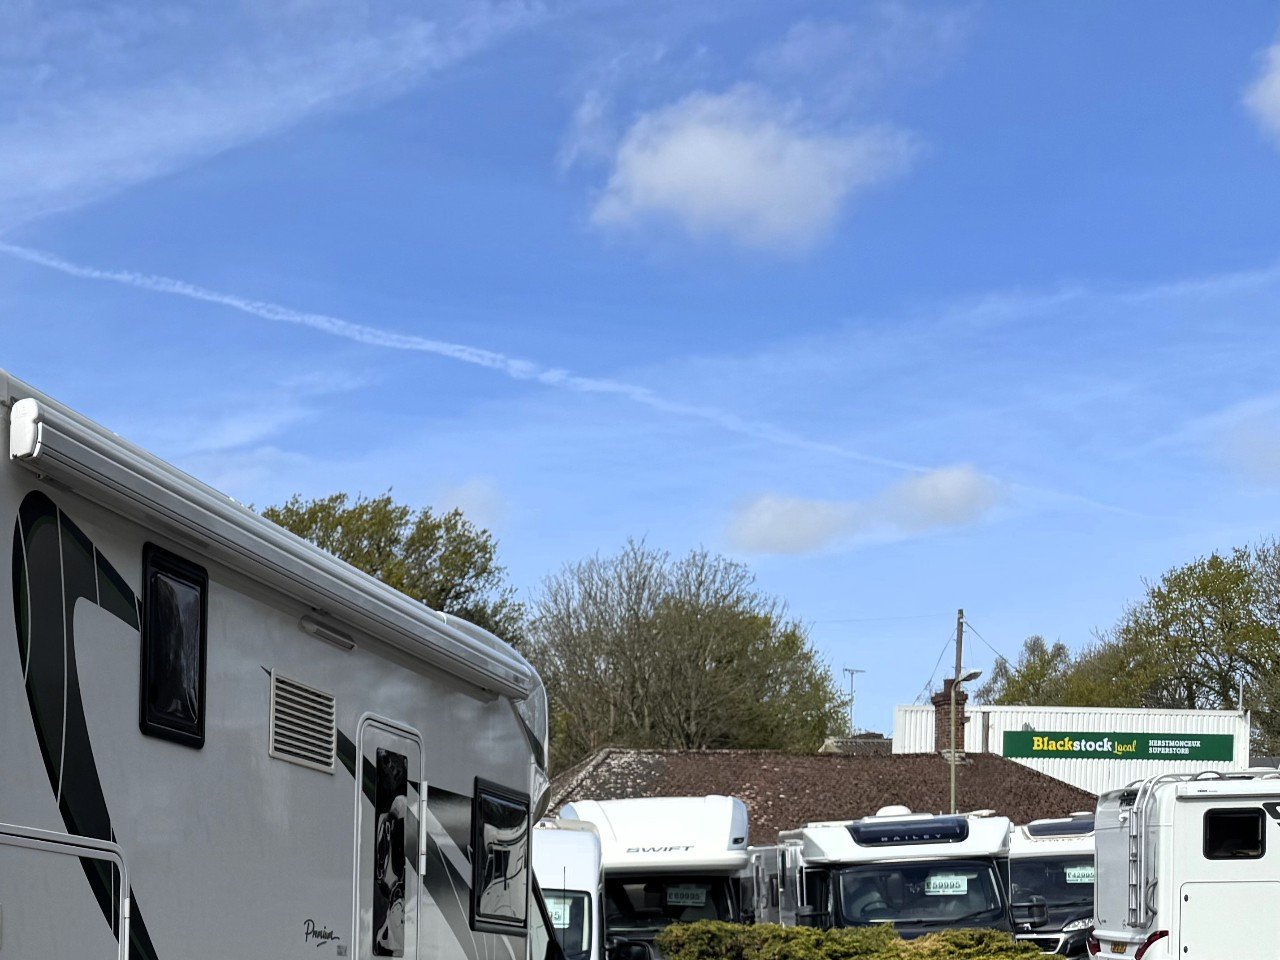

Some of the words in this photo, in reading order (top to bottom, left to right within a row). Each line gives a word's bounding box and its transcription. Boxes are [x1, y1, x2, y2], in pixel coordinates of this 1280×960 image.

[1032, 736, 1113, 752] Blackstock
[1113, 739, 1137, 755] Local
[881, 833, 941, 842] BAILEY
[626, 845, 695, 853] SWIFT
